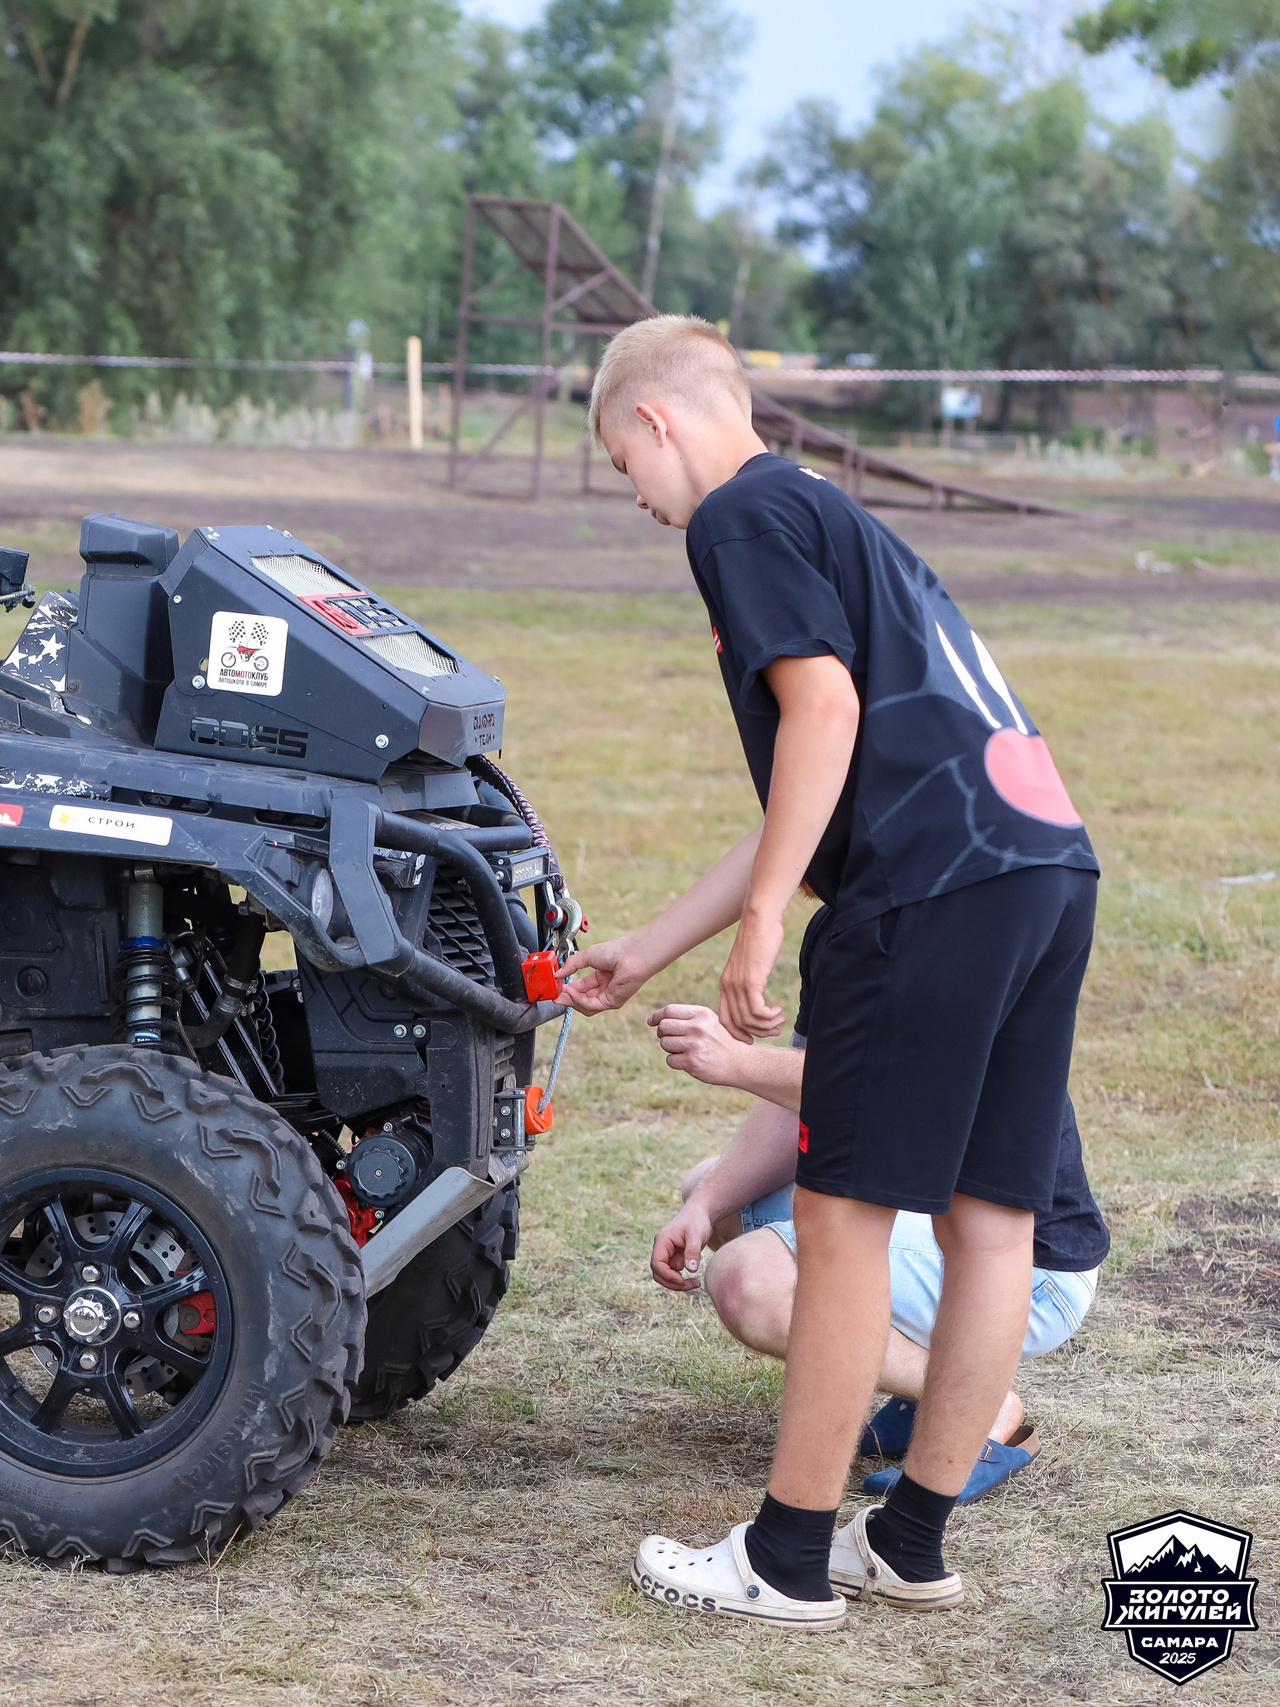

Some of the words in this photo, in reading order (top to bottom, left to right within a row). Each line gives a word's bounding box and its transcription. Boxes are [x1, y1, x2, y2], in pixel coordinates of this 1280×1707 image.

[220, 668, 269, 681] АВТОМОТОКЛУБ
[189, 716, 309, 759] ODES
[172, 1381, 272, 1493] MARSWAY
[640, 1574, 716, 1612] crocs
